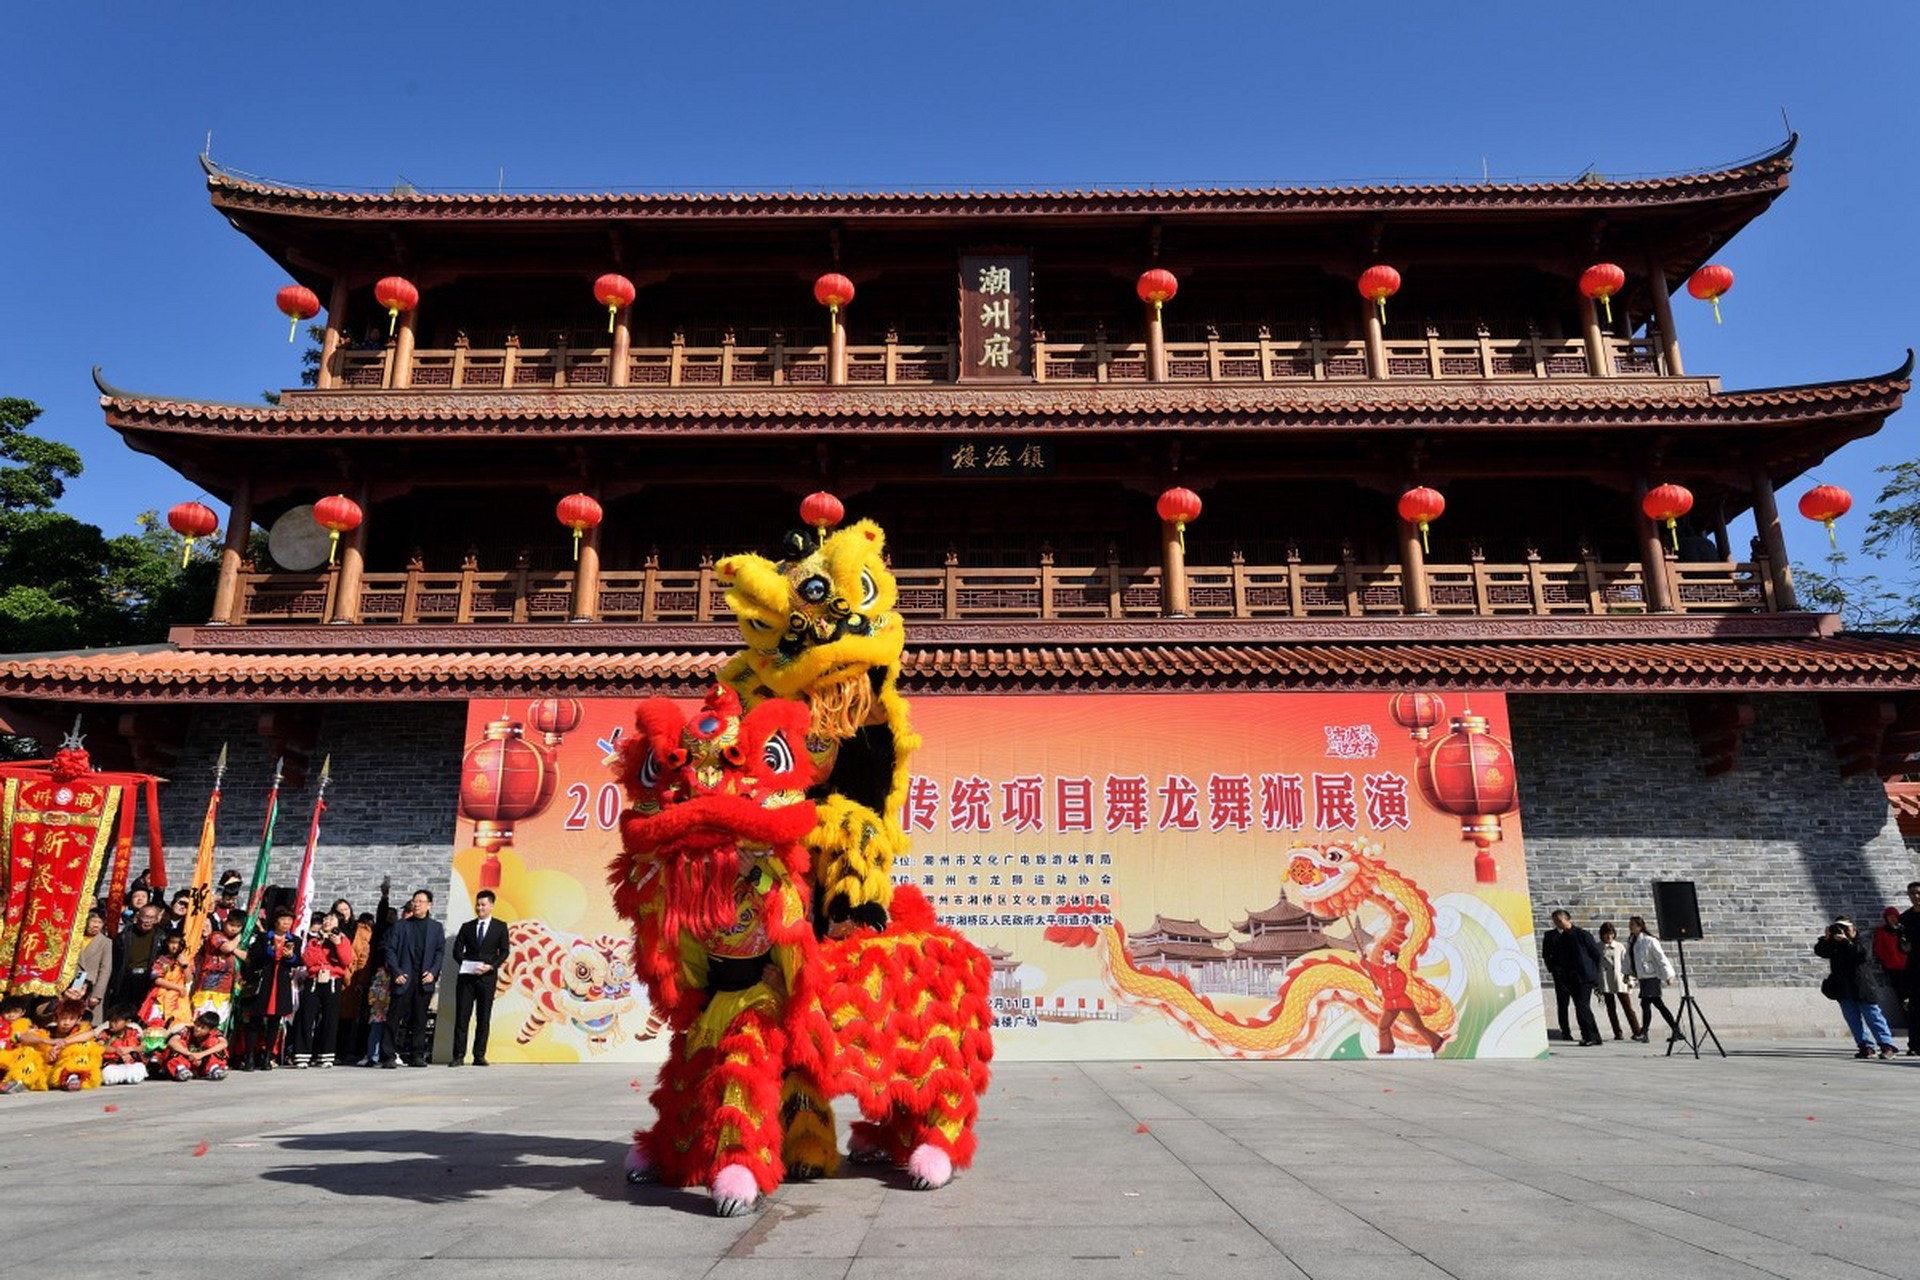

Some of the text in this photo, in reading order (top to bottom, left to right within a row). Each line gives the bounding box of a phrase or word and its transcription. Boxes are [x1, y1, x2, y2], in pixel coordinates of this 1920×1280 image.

[978, 265, 1013, 368] 潮州府
[564, 773, 1410, 832] 20 传统项目舞龙舞狮展演
